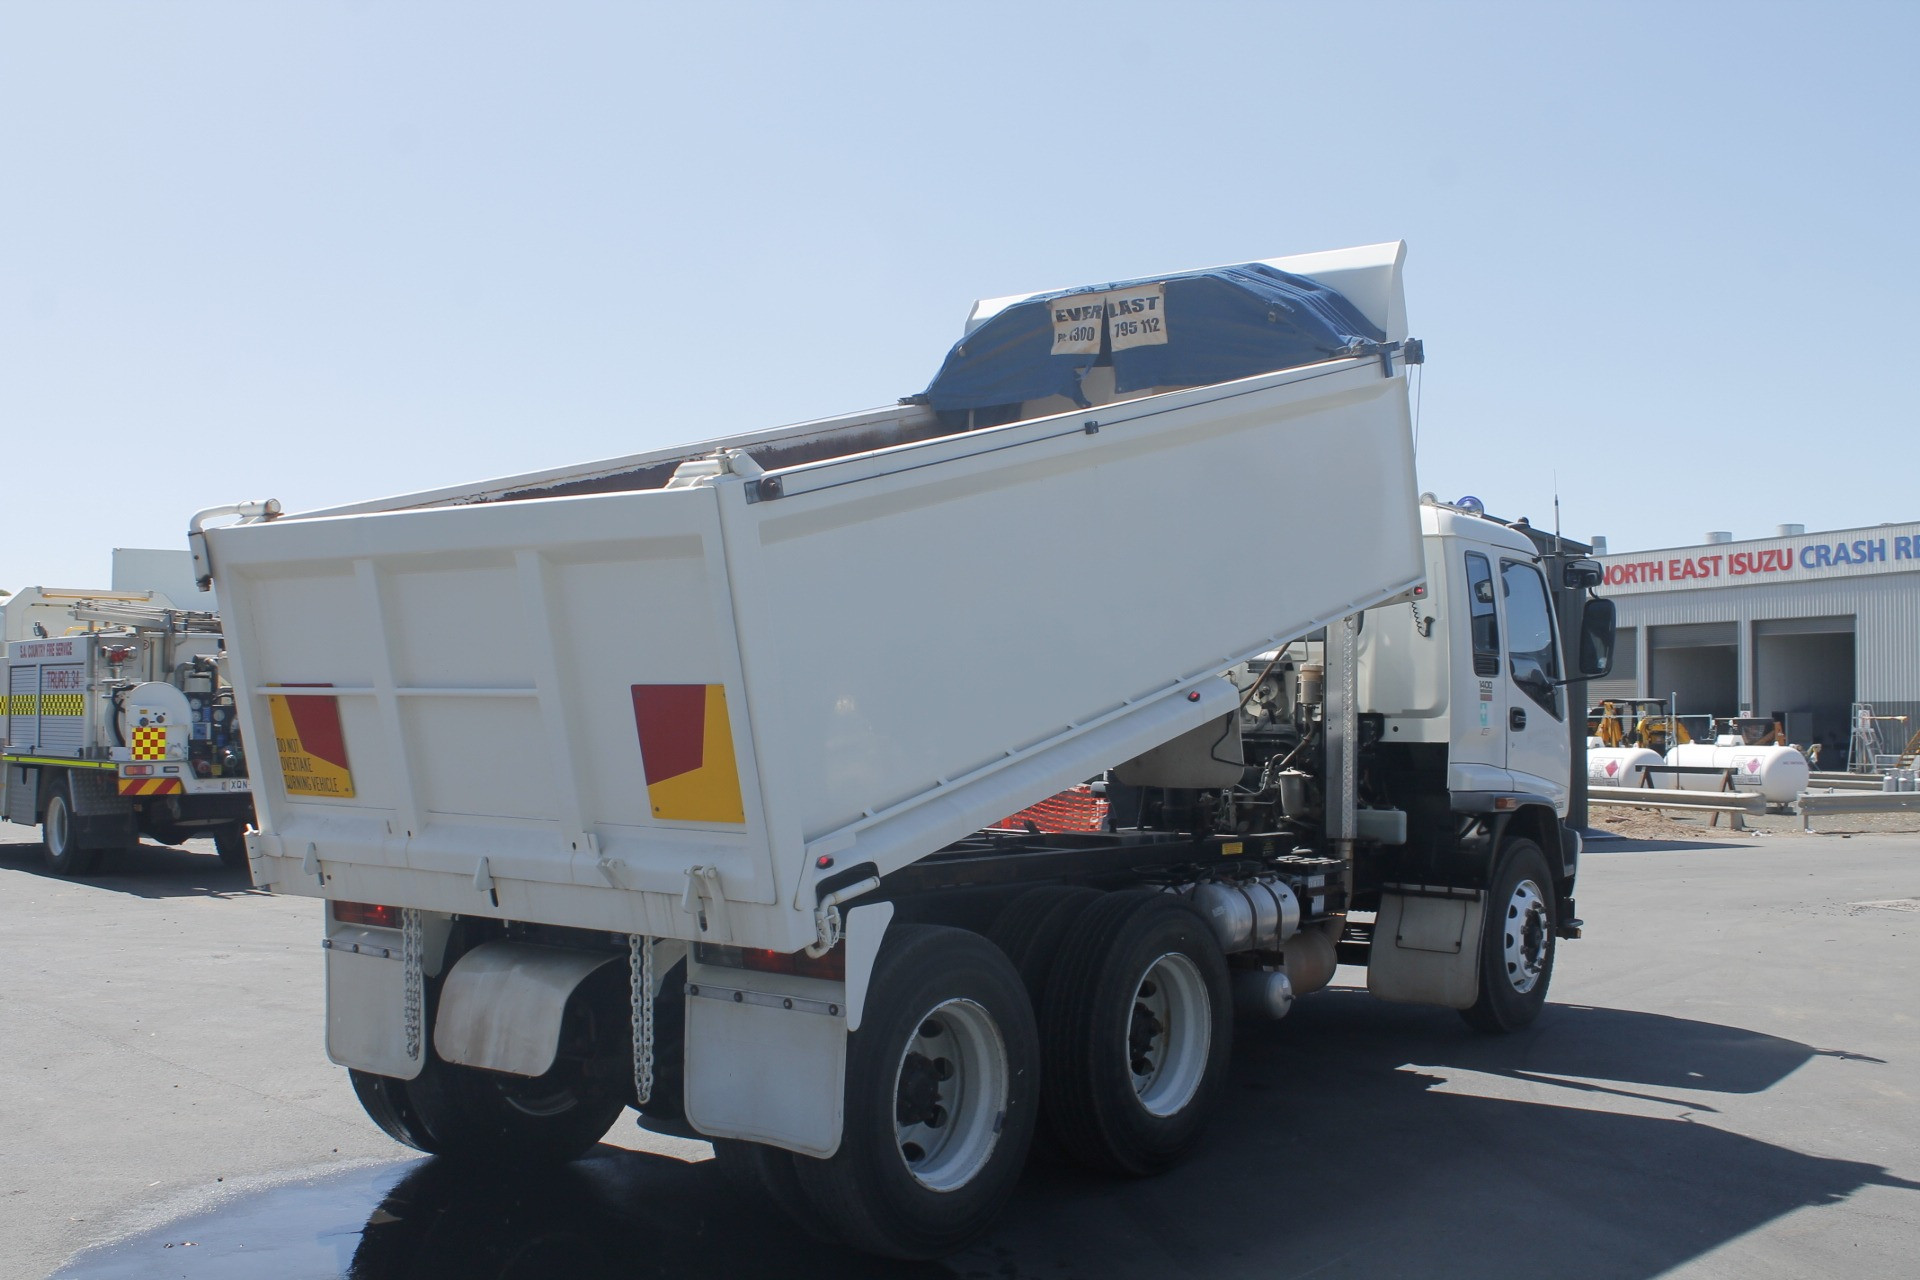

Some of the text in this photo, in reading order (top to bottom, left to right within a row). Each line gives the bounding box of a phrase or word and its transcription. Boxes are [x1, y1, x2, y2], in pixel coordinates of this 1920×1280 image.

[1141, 317, 1160, 334] 112
[1668, 555, 1723, 581] EAST
[1728, 548, 1793, 576] ISUZU
[1800, 538, 1886, 569] CRASH
[28, 643, 46, 657] COUNTRY
[47, 642, 55, 656] FIRE
[56, 641, 72, 656] SERVICE
[47, 670, 80, 689] TRURO 34
[276, 737, 301, 753] DO NOT
[280, 756, 314, 773] OVERTAKE
[284, 774, 340, 793] TURNING VEHICLE
